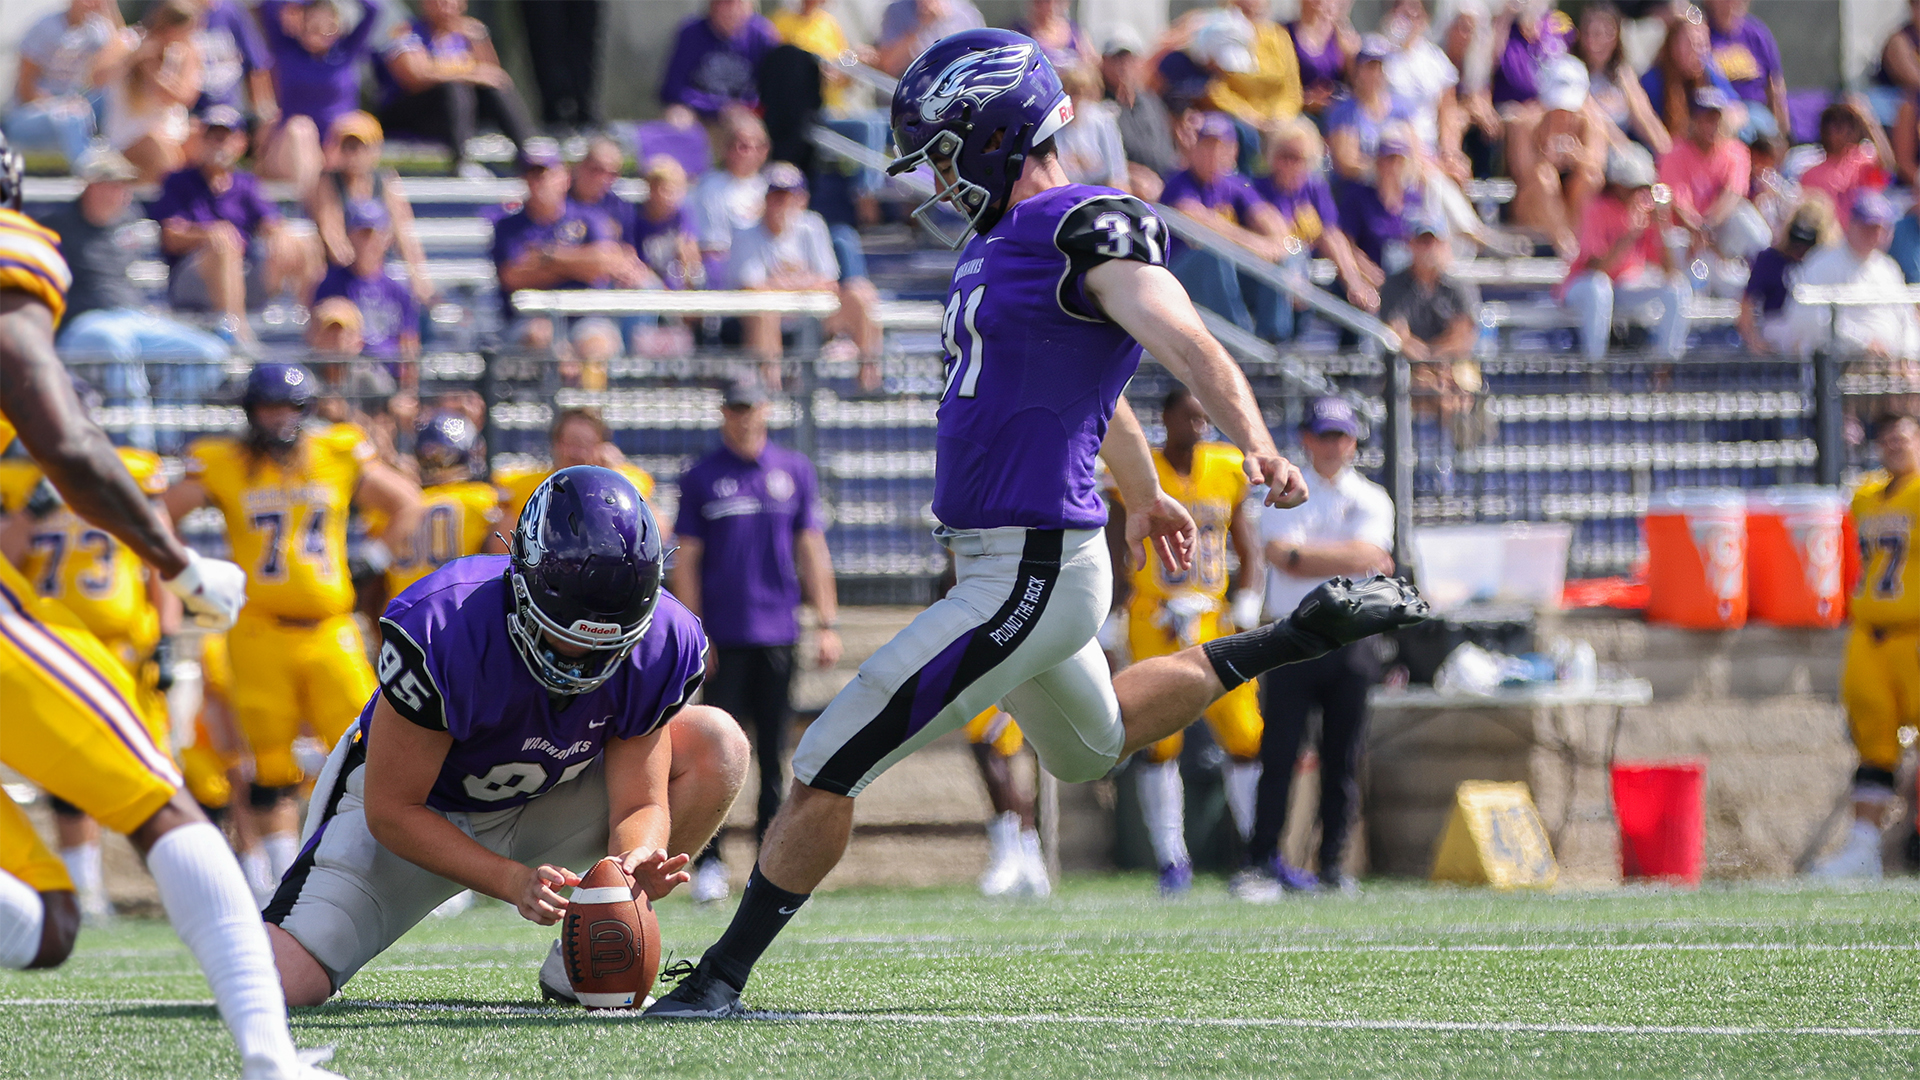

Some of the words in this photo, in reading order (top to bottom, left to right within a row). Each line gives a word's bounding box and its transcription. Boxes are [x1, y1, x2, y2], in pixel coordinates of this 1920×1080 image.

[1094, 211, 1163, 264] 31
[30, 529, 119, 597] 73
[250, 509, 332, 584] 74
[1013, 600, 1036, 621] THE
[1023, 574, 1046, 604] ROCK
[579, 623, 618, 635] Riddell
[989, 614, 1024, 647] POUND
[378, 640, 431, 711] 95
